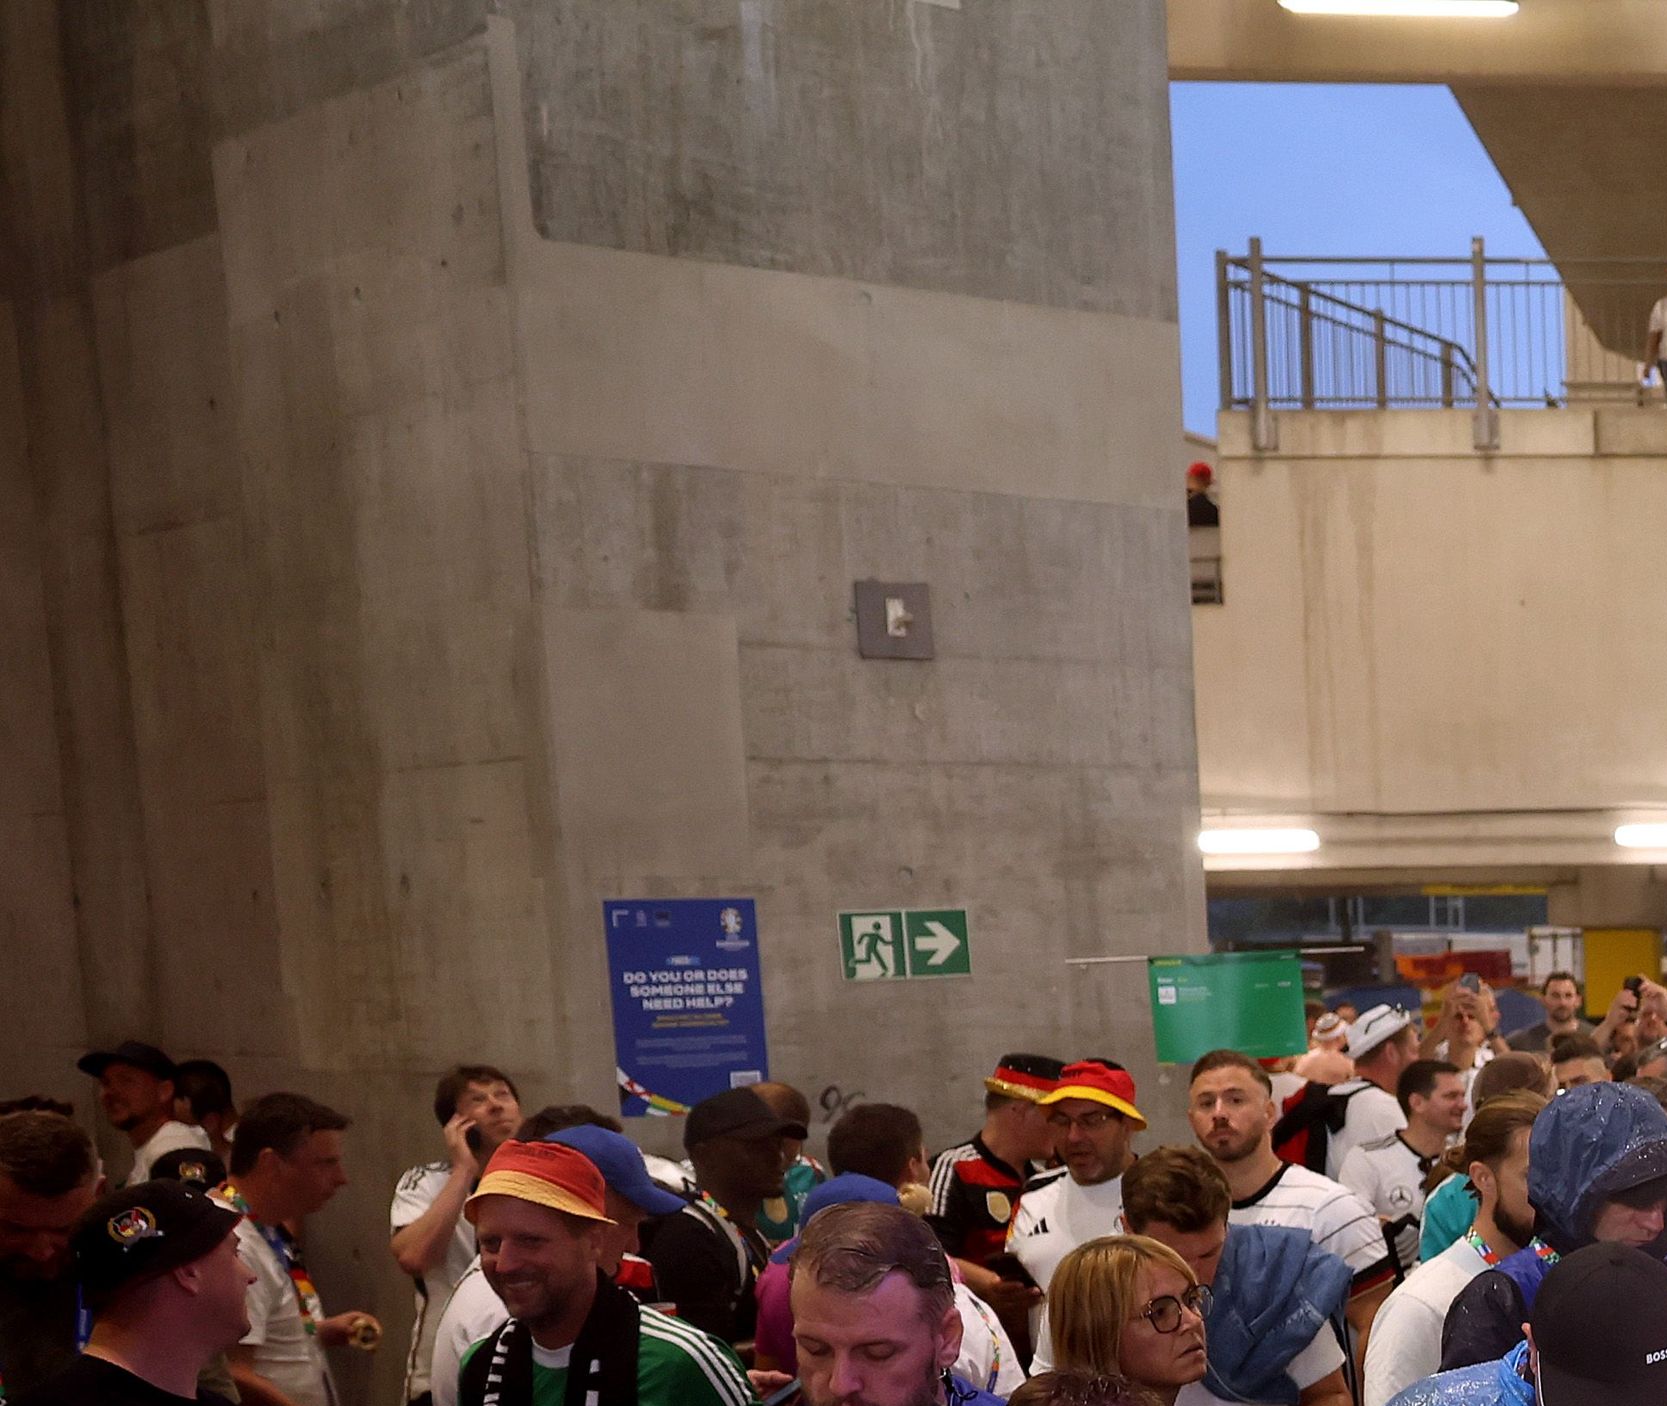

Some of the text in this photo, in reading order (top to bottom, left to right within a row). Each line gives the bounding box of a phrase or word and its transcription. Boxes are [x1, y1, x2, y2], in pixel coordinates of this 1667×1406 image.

[623, 967, 748, 984] DO YOU OR DOES
[630, 981, 744, 998] SOMEONE ELSE
[642, 995, 734, 1010] NEED HELP?
